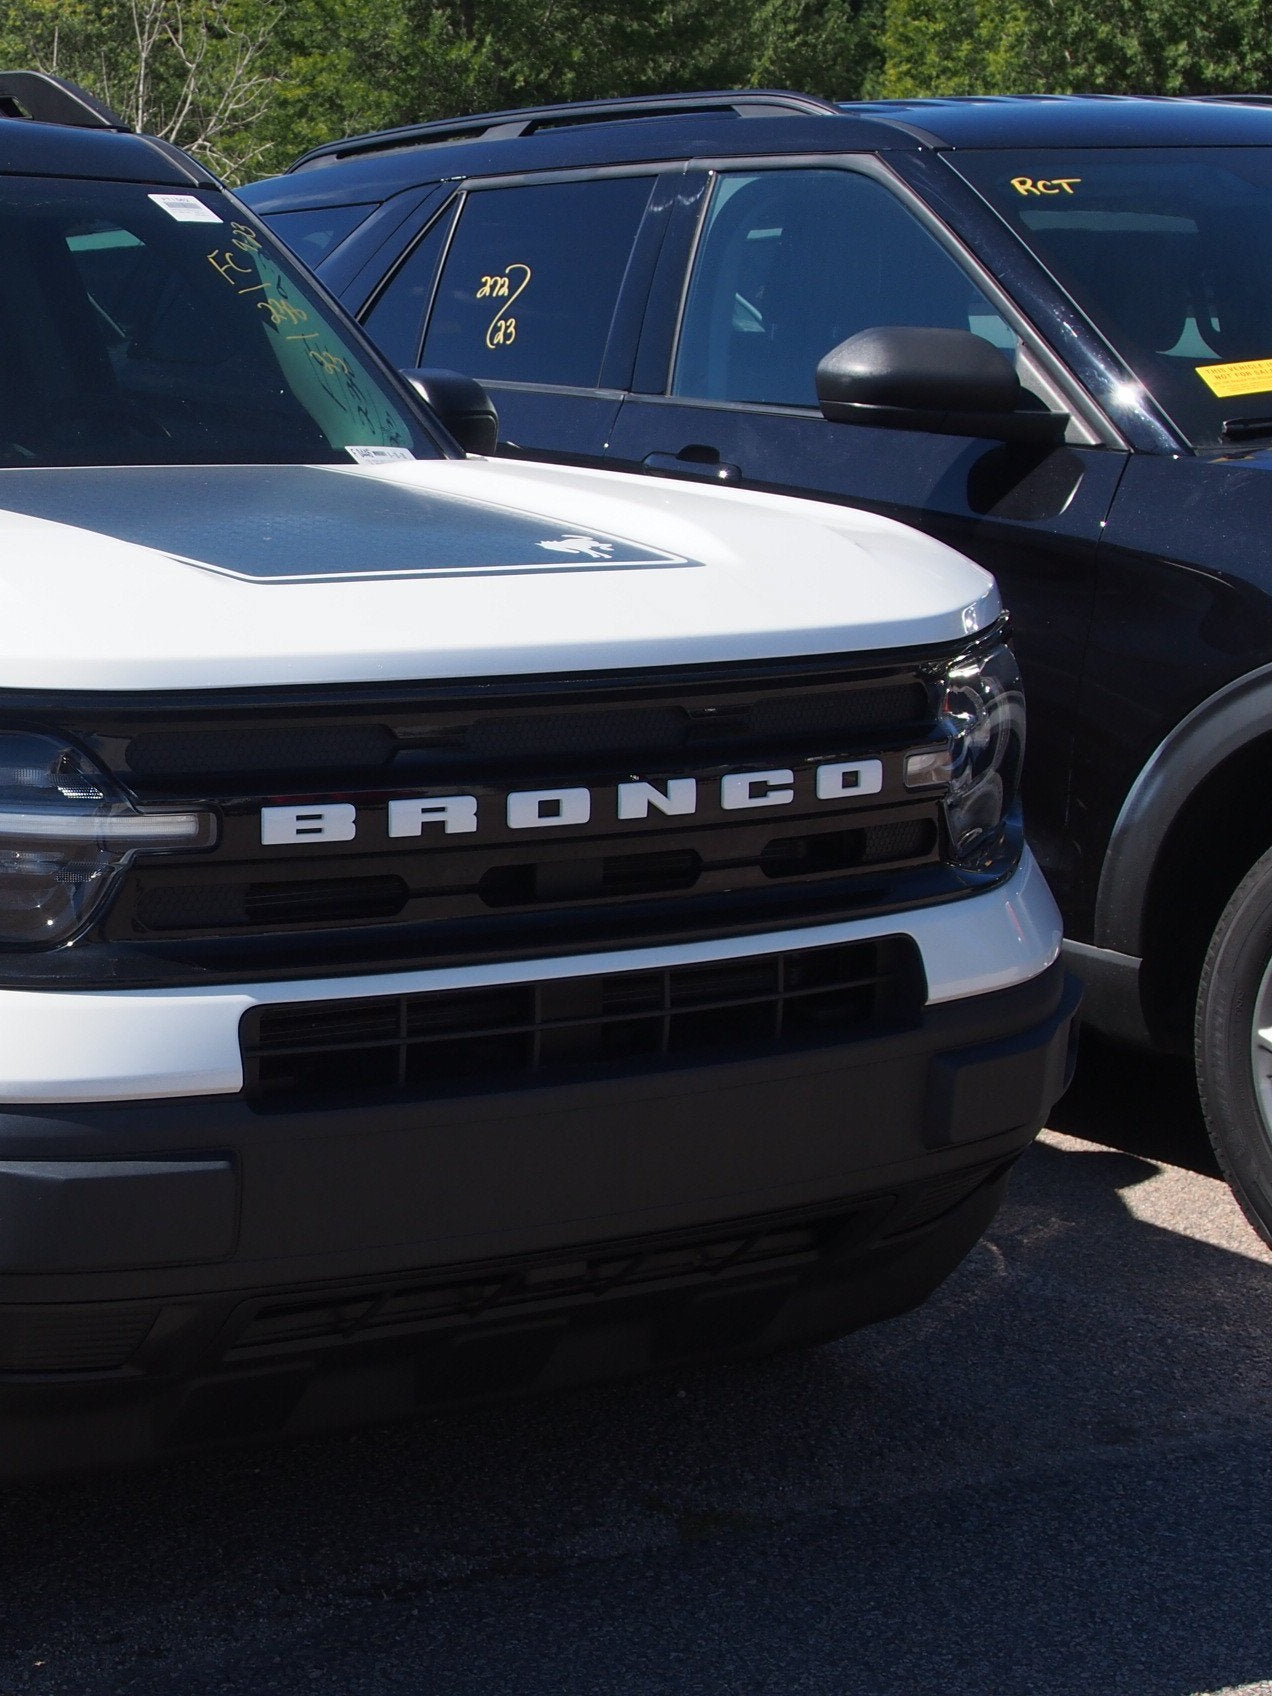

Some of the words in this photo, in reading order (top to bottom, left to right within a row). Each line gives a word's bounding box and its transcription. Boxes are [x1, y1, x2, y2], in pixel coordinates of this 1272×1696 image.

[1010, 176, 1082, 196] RCT
[476, 275, 509, 298] 272
[493, 317, 516, 344] 23
[260, 758, 884, 846] BRONCO
